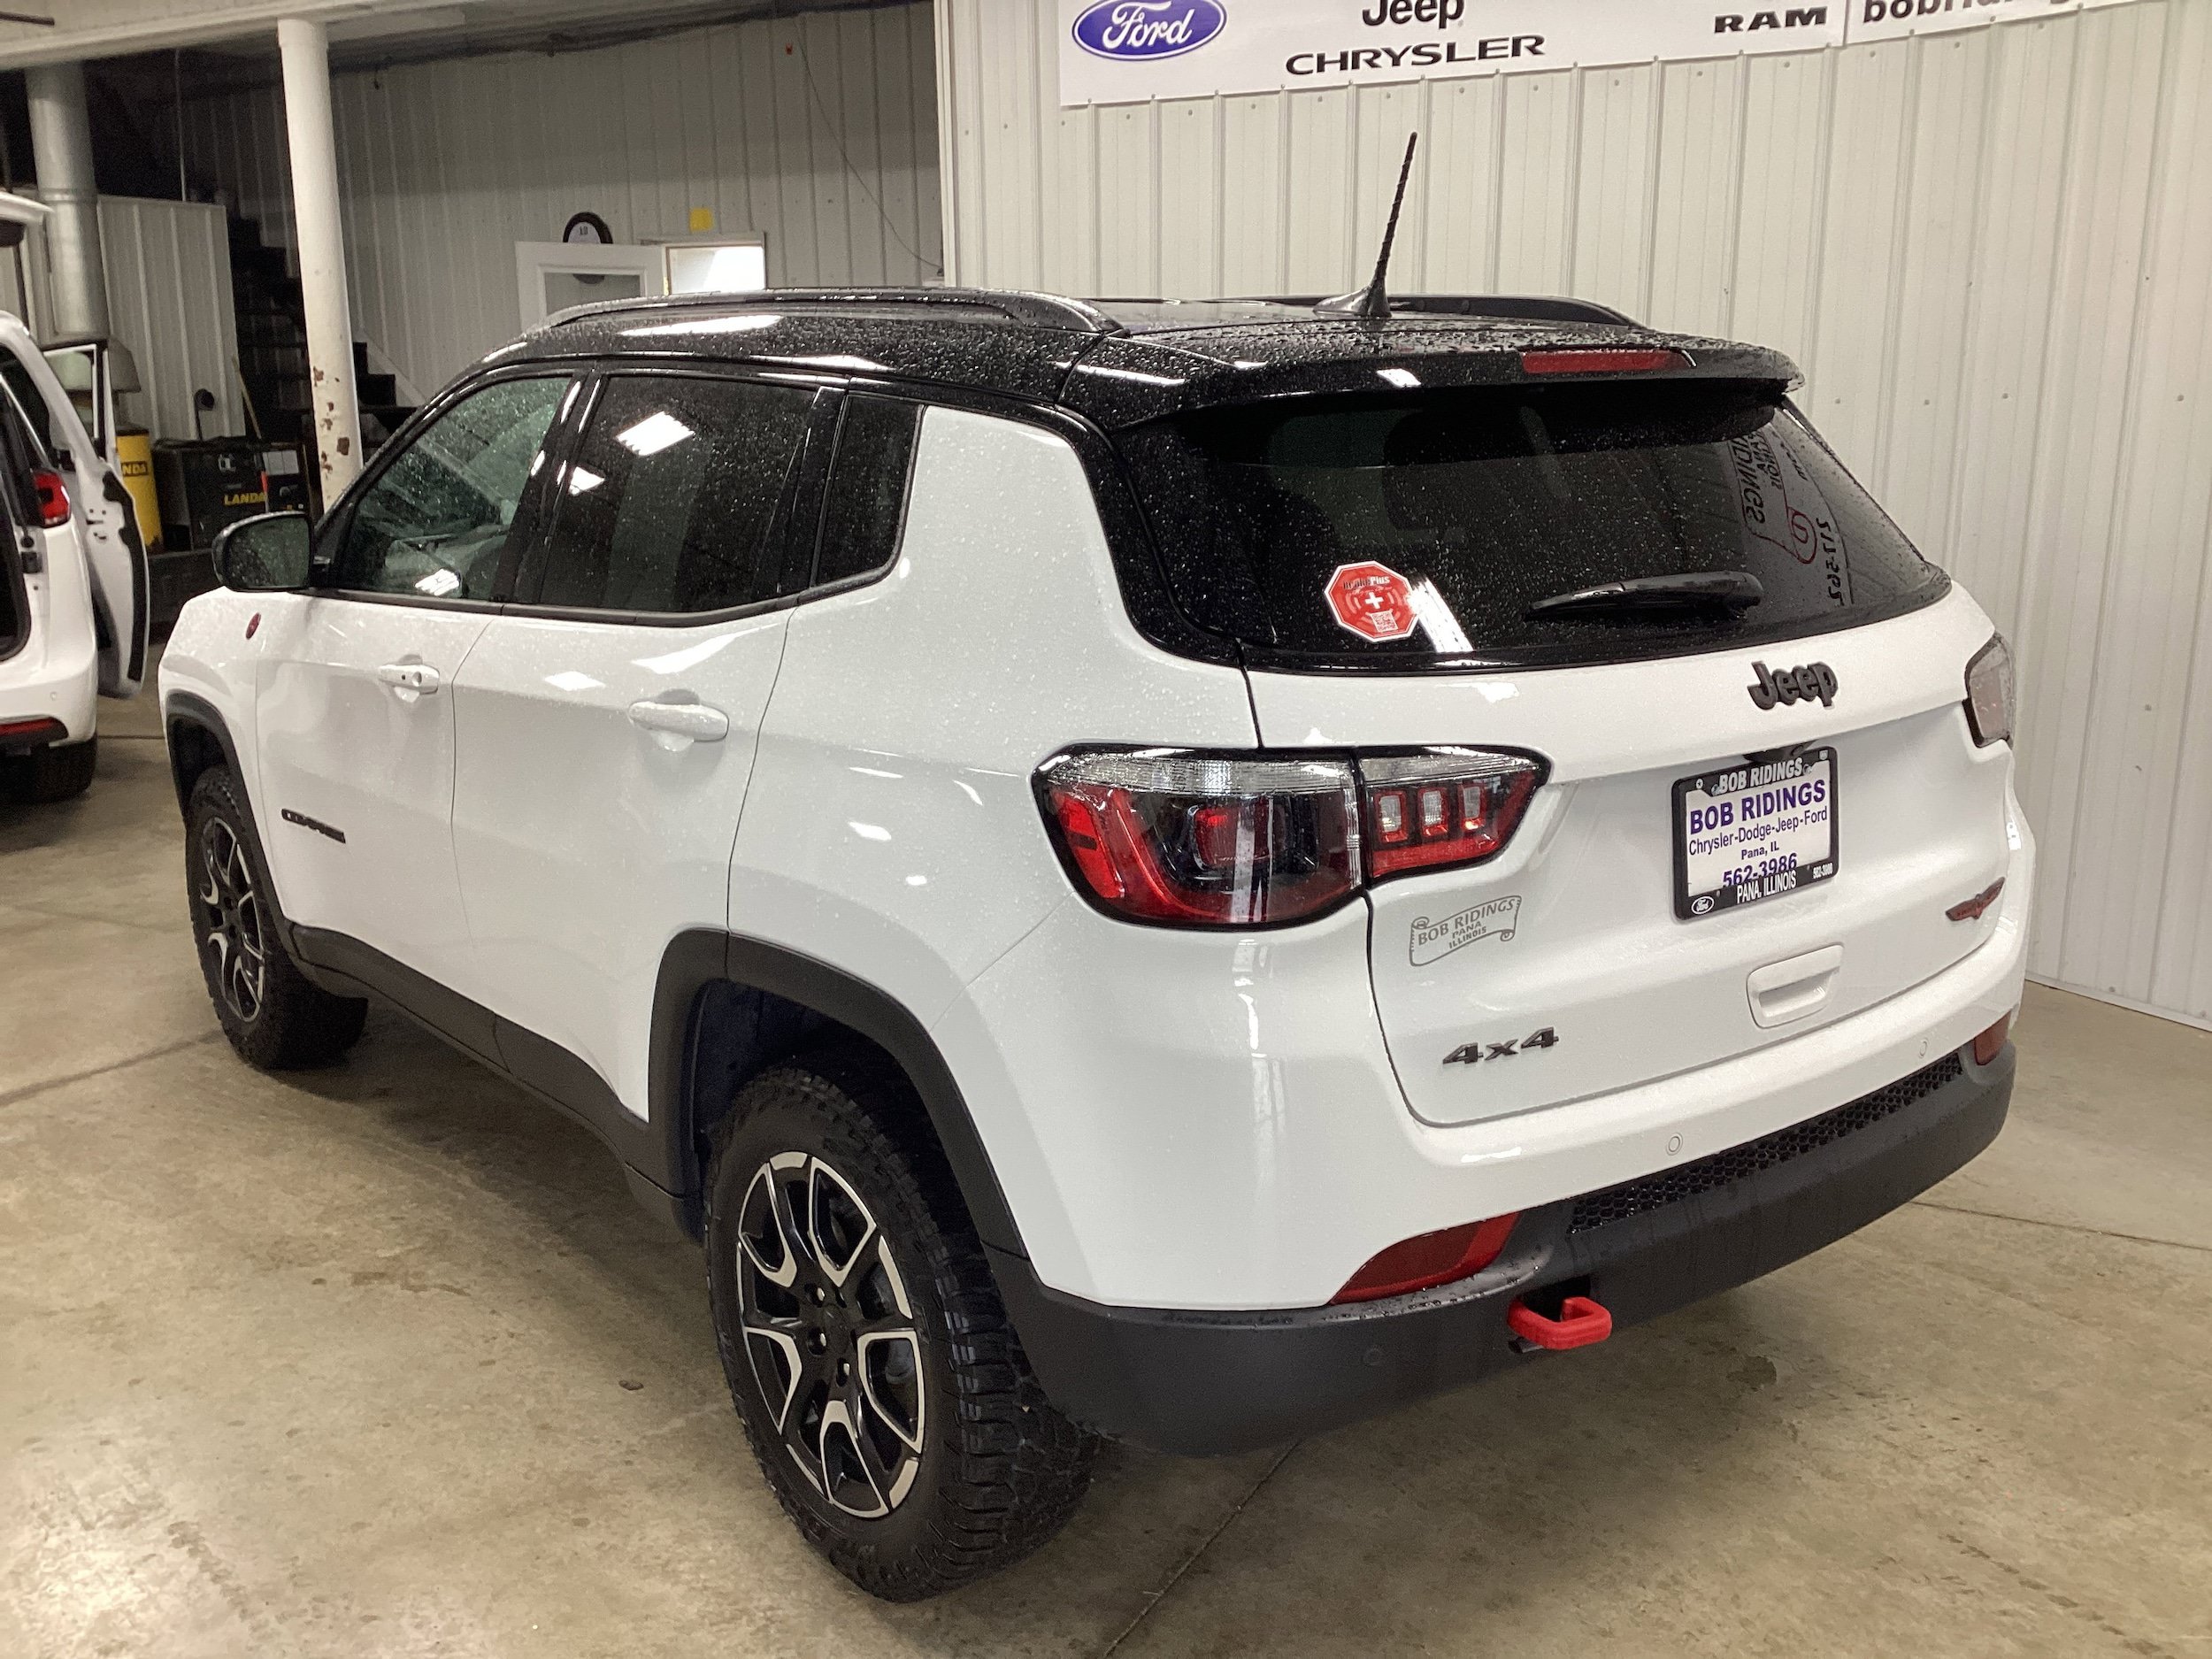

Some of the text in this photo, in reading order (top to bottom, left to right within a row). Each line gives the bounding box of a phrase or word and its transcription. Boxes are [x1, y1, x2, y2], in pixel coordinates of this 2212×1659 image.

[1102, 2, 1194, 48] Ford
[1362, 0, 1464, 30] Jeep
[1713, 7, 1828, 34] RAM
[1285, 35, 1546, 76] CHRYSLER
[1747, 661, 1839, 710] Jeep
[1718, 757, 1803, 795] BOB RIDINGS
[1690, 779, 1826, 835] BOB RIDINGS
[1688, 806, 1828, 856] Chrysler-Dodge-Jeep-Ford
[1722, 851, 1798, 887] 562-3986
[1740, 841, 1780, 860] Pana, IL
[1763, 869, 1797, 896] ILLINOIS
[1417, 898, 1516, 946] BOB RIDINGS
[1448, 926, 1487, 949] ILLINOIS
[1452, 920, 1482, 939] PANA
[1442, 1026, 1560, 1065] 4x4
